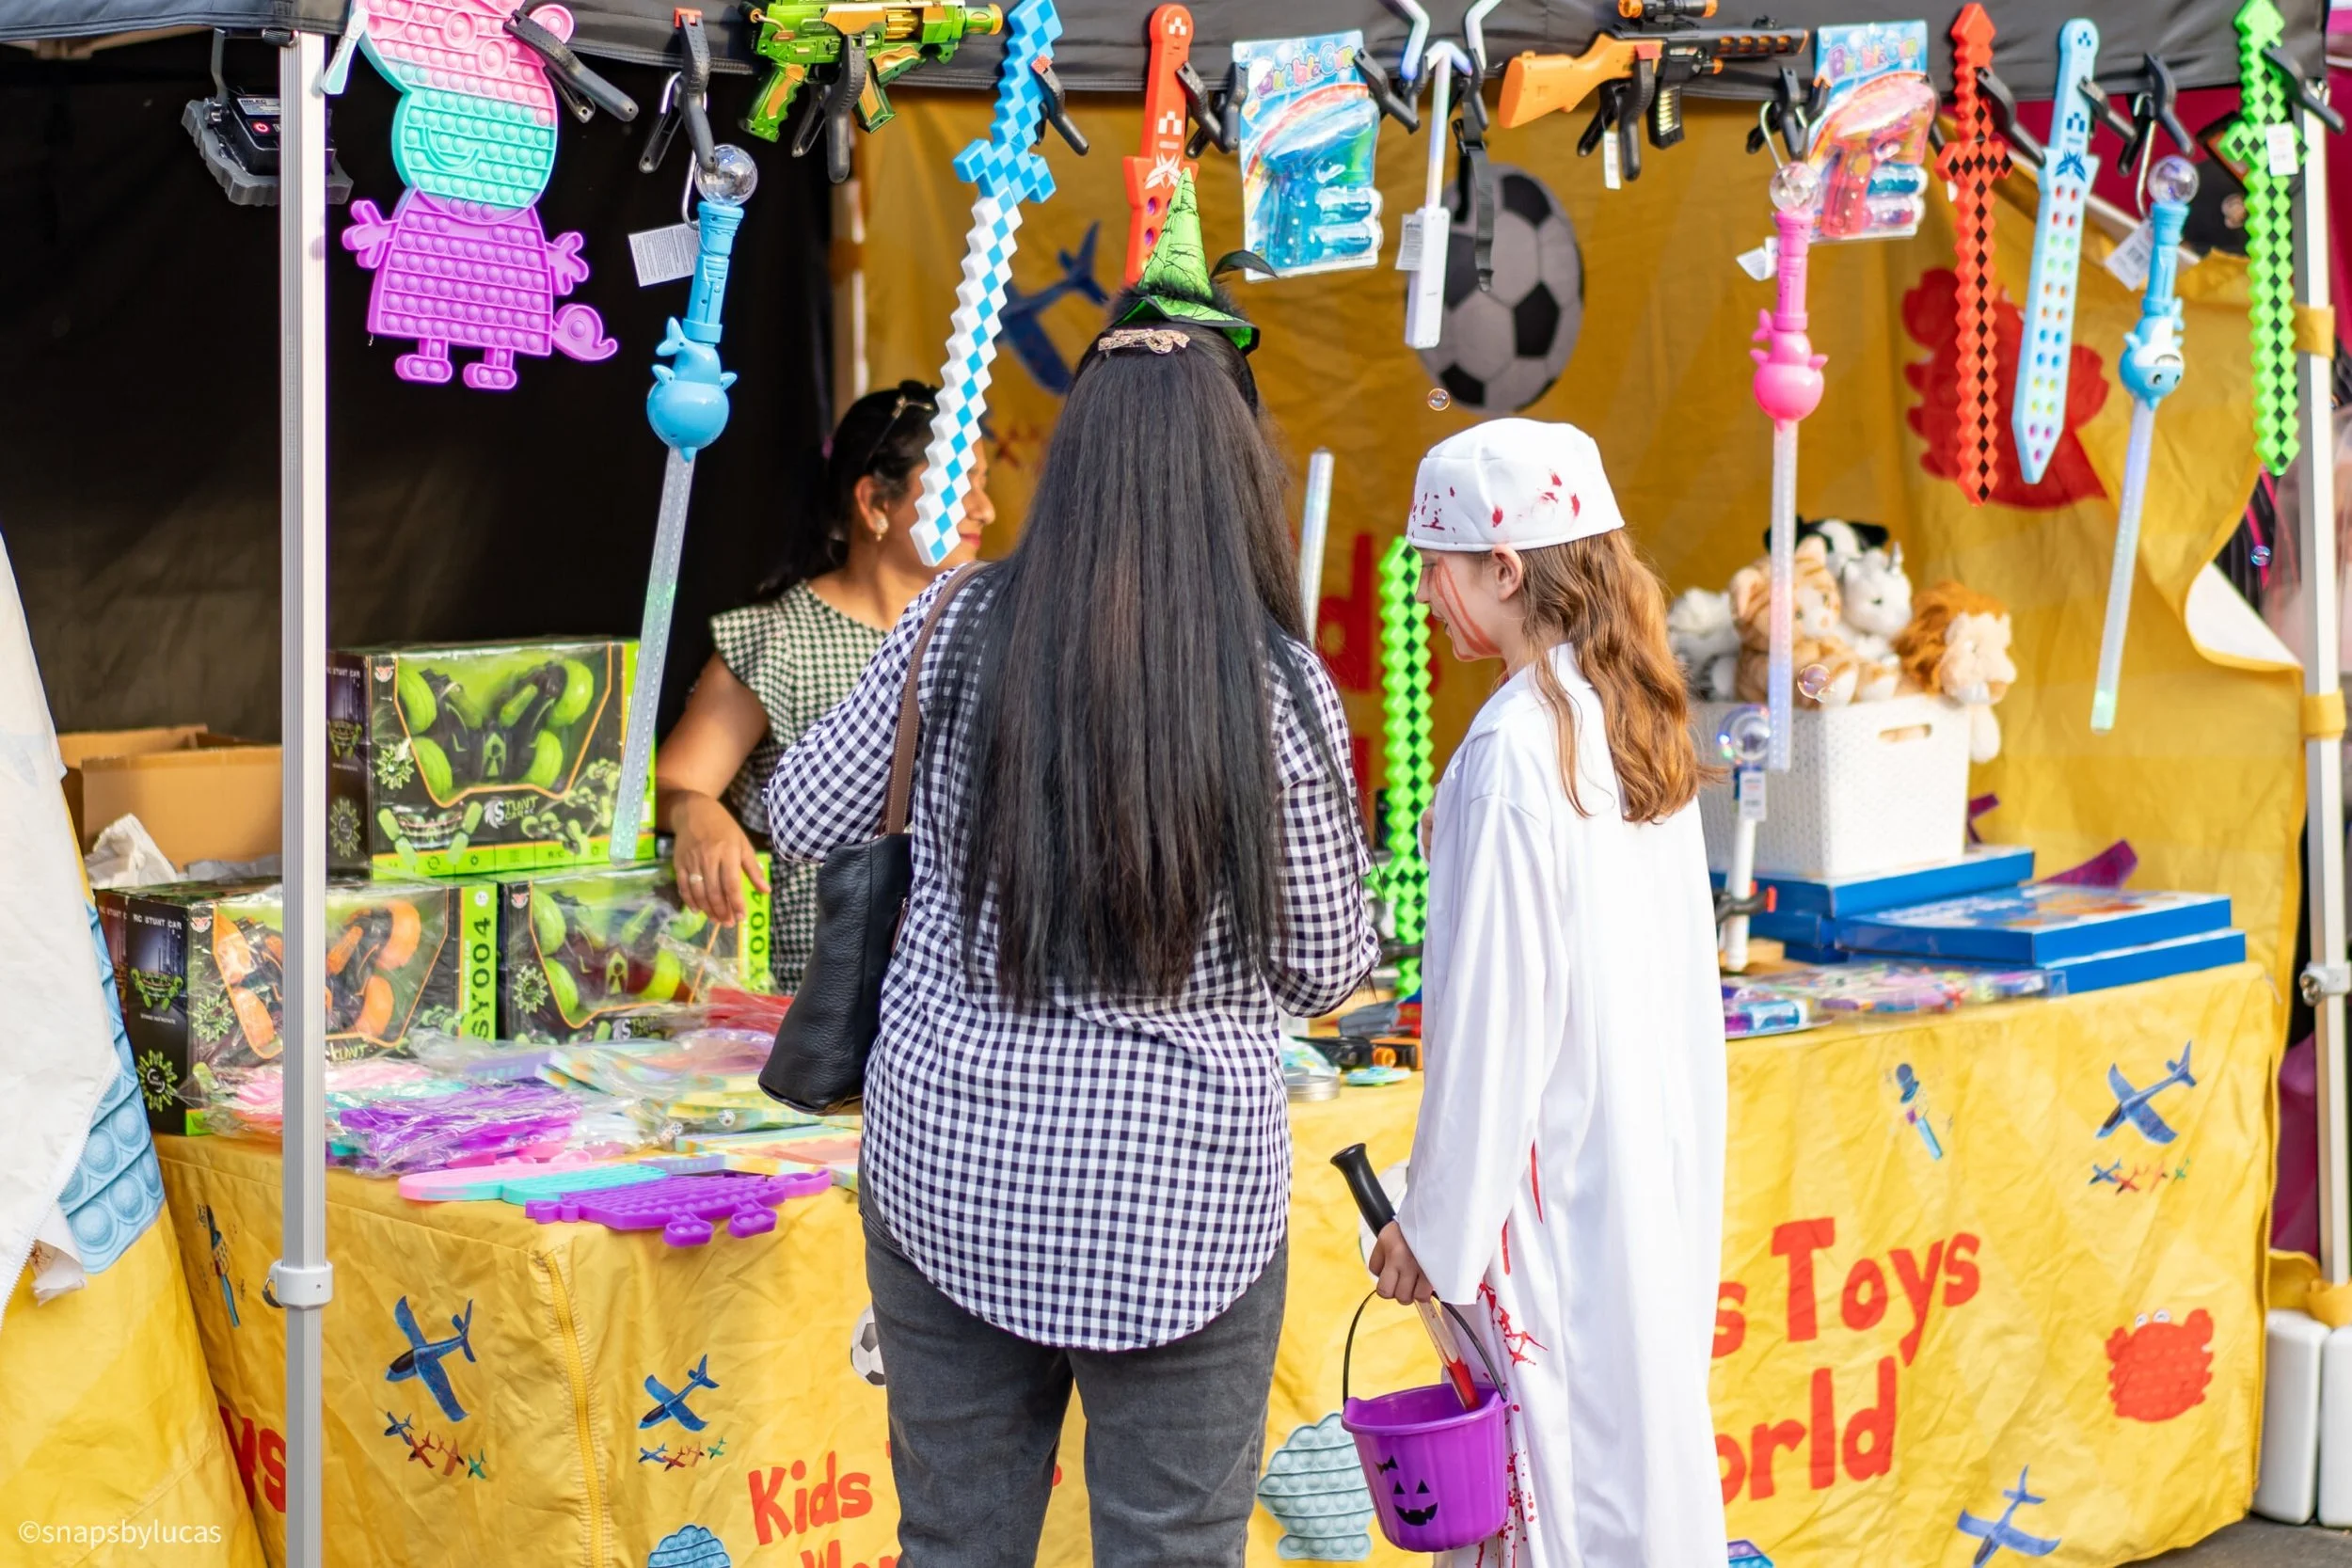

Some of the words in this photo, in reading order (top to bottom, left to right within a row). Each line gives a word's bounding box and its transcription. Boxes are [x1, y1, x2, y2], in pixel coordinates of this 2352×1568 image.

[133, 914, 142, 924] RC
[145, 917, 166, 927] STUNT
[167, 919, 183, 930] CAR
[1771, 1216, 1981, 1368] Toys
[1713, 1354, 1897, 1507] orld
[748, 1449, 873, 1546] Kids
